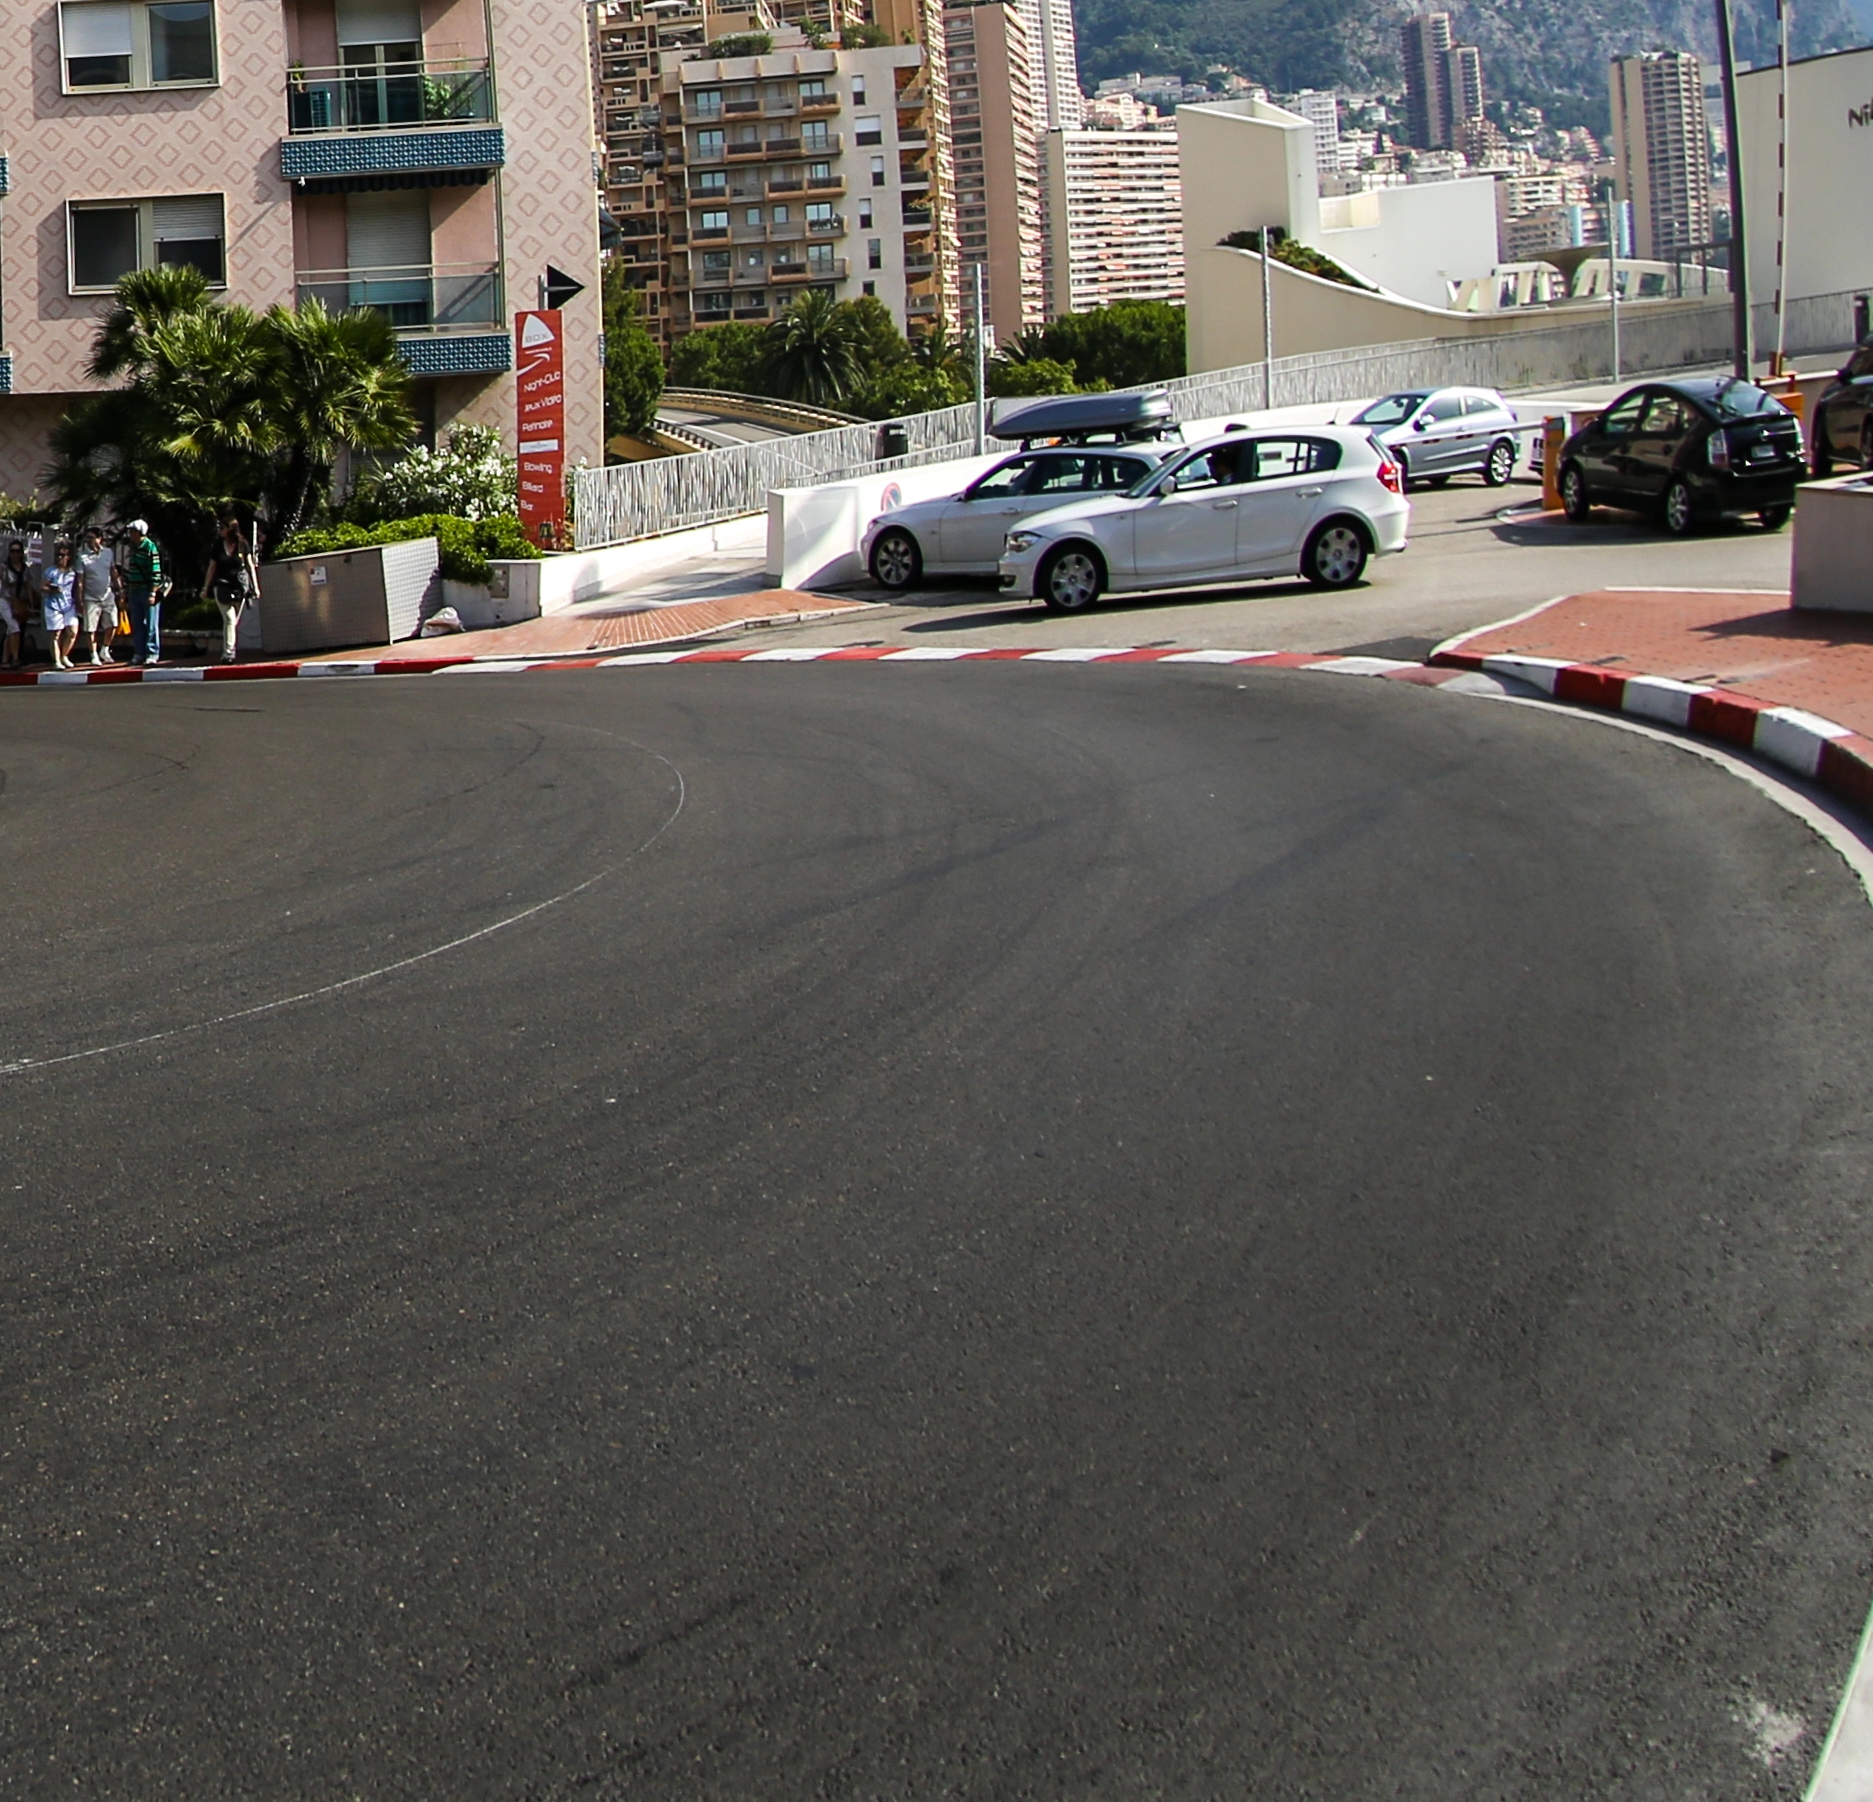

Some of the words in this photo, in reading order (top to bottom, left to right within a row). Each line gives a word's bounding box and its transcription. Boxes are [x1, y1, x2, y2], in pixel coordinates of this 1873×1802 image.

[525, 332, 548, 343] BOX
[523, 461, 553, 474] Bowling
[520, 499, 534, 511] Bar
